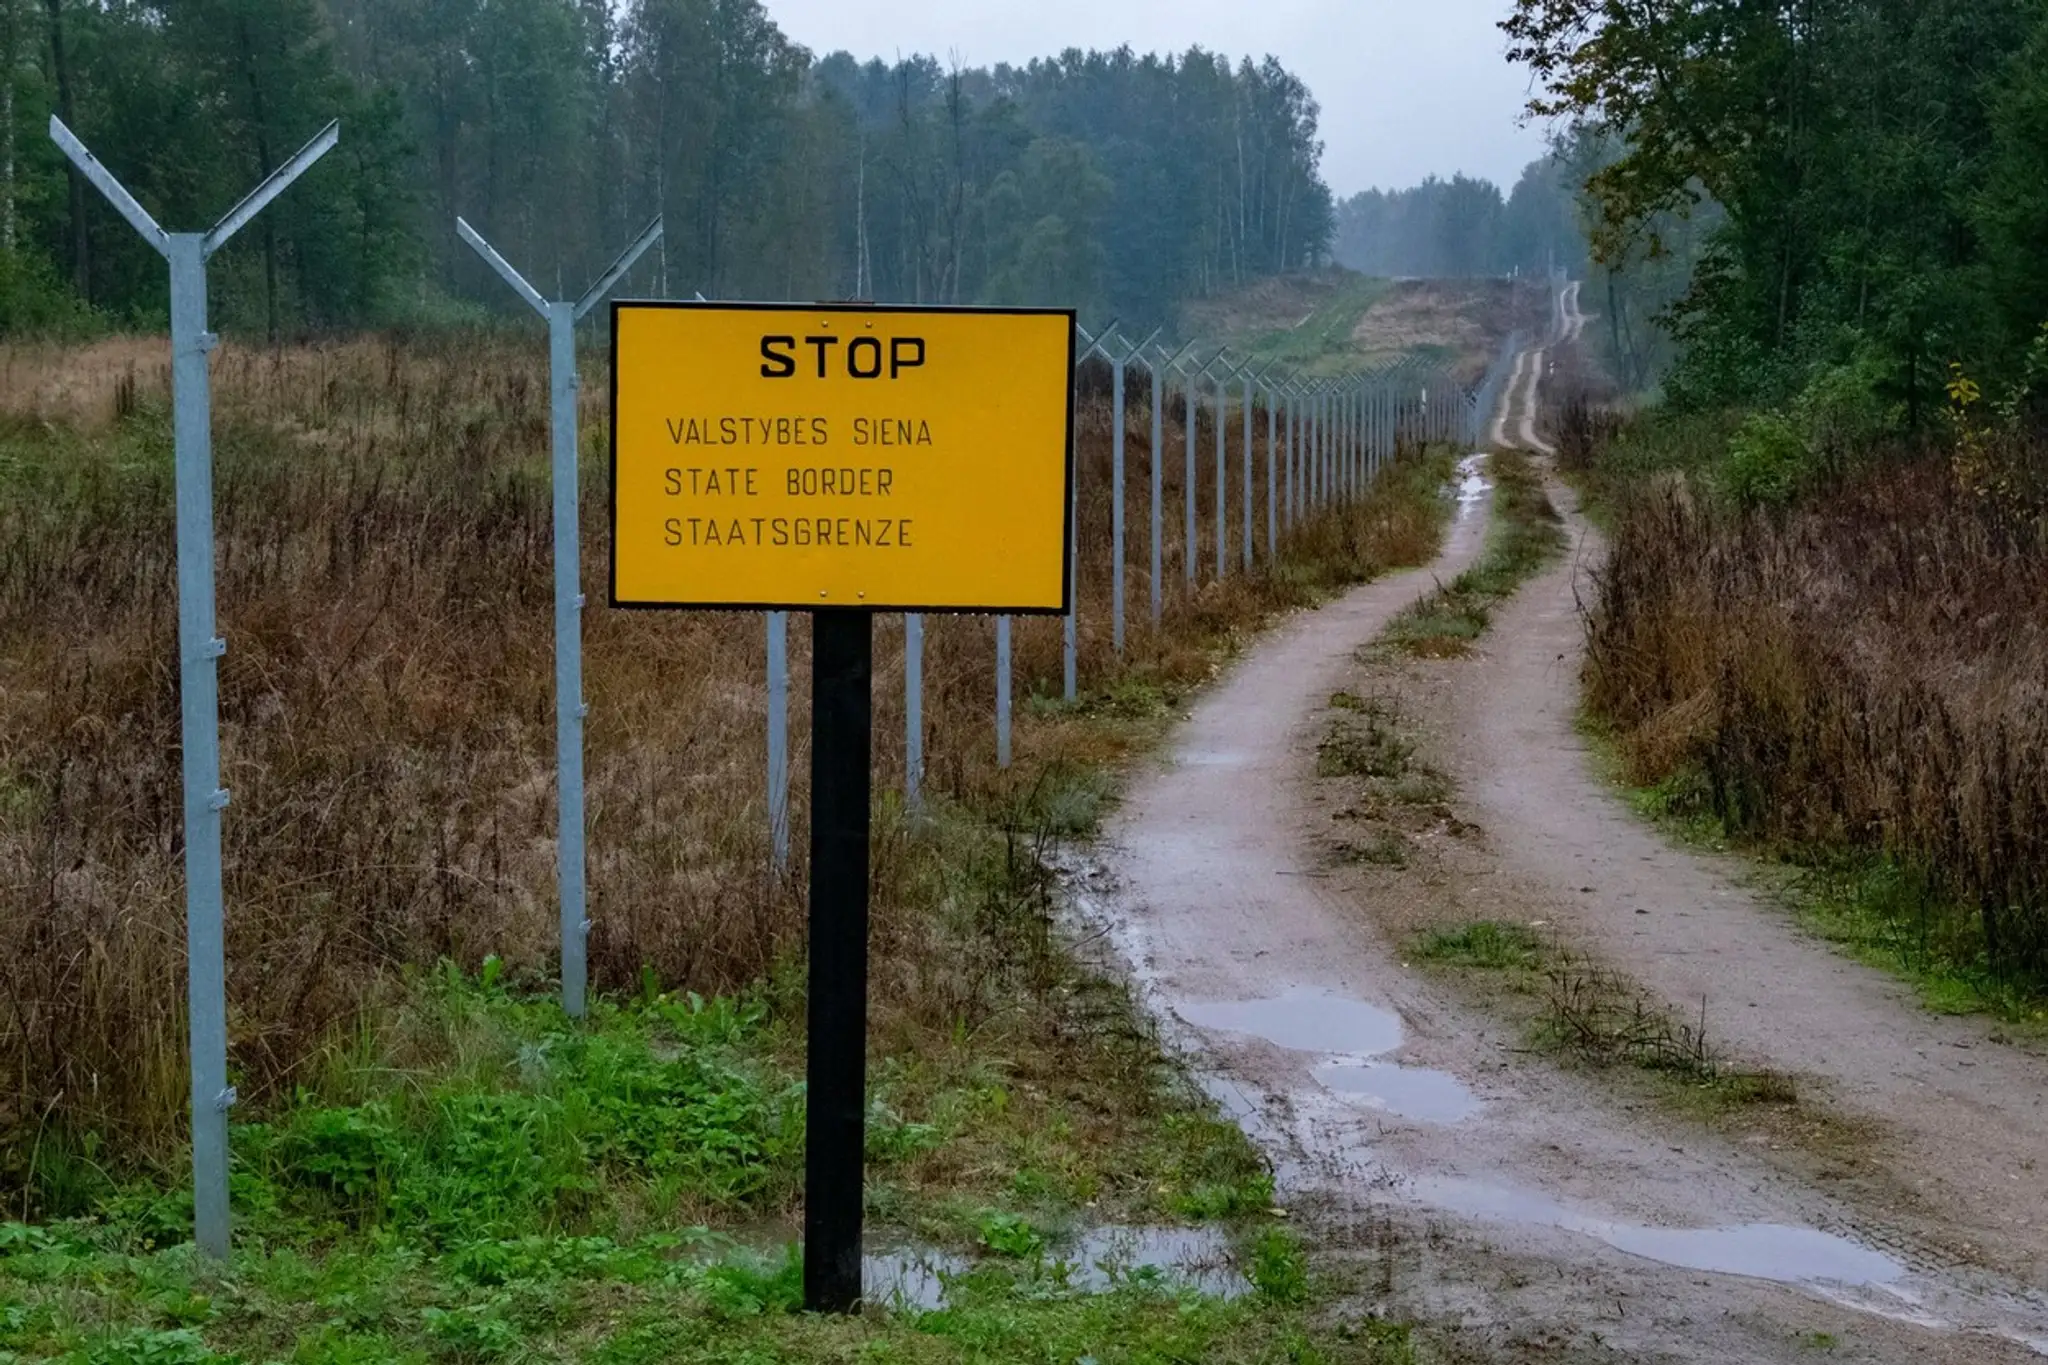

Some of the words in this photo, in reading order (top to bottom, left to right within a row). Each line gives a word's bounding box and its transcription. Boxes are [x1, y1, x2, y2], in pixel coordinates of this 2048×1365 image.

[760, 335, 926, 380] STOP
[853, 418, 933, 446] SIENA
[665, 468, 759, 496] STATE
[787, 468, 894, 496] BORDER
[665, 518, 914, 547] STAATSGRENZE
